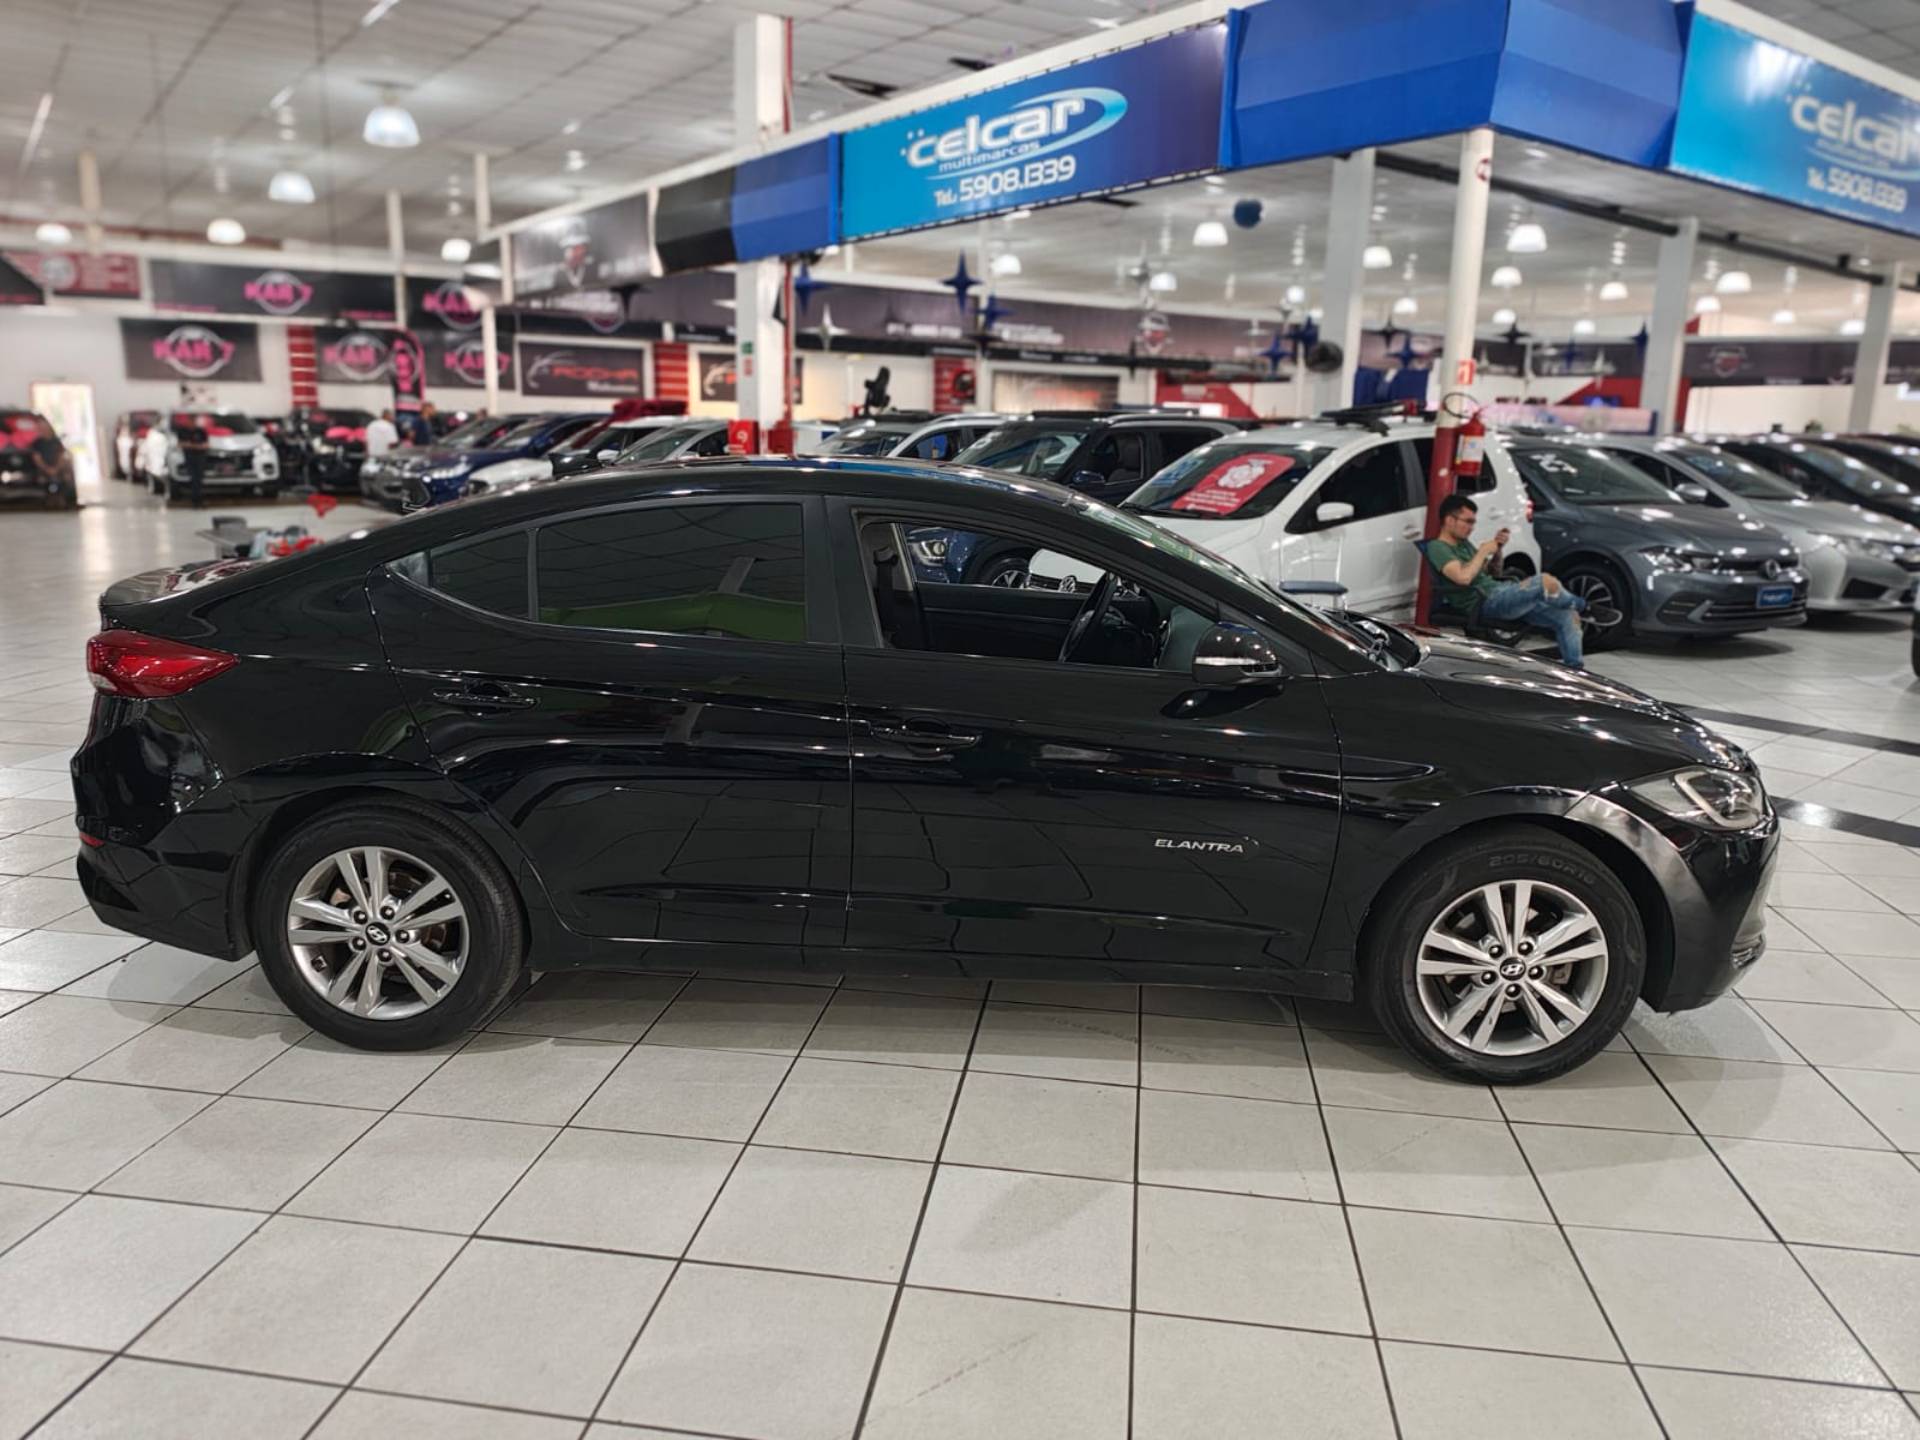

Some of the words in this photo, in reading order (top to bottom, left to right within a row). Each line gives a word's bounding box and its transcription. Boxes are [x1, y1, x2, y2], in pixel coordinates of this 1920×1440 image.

[907, 97, 1086, 168] celcar
[938, 140, 1041, 174] multimarcas
[959, 155, 1077, 202] 5908.1339
[1154, 838, 1244, 853] ELANTRA
